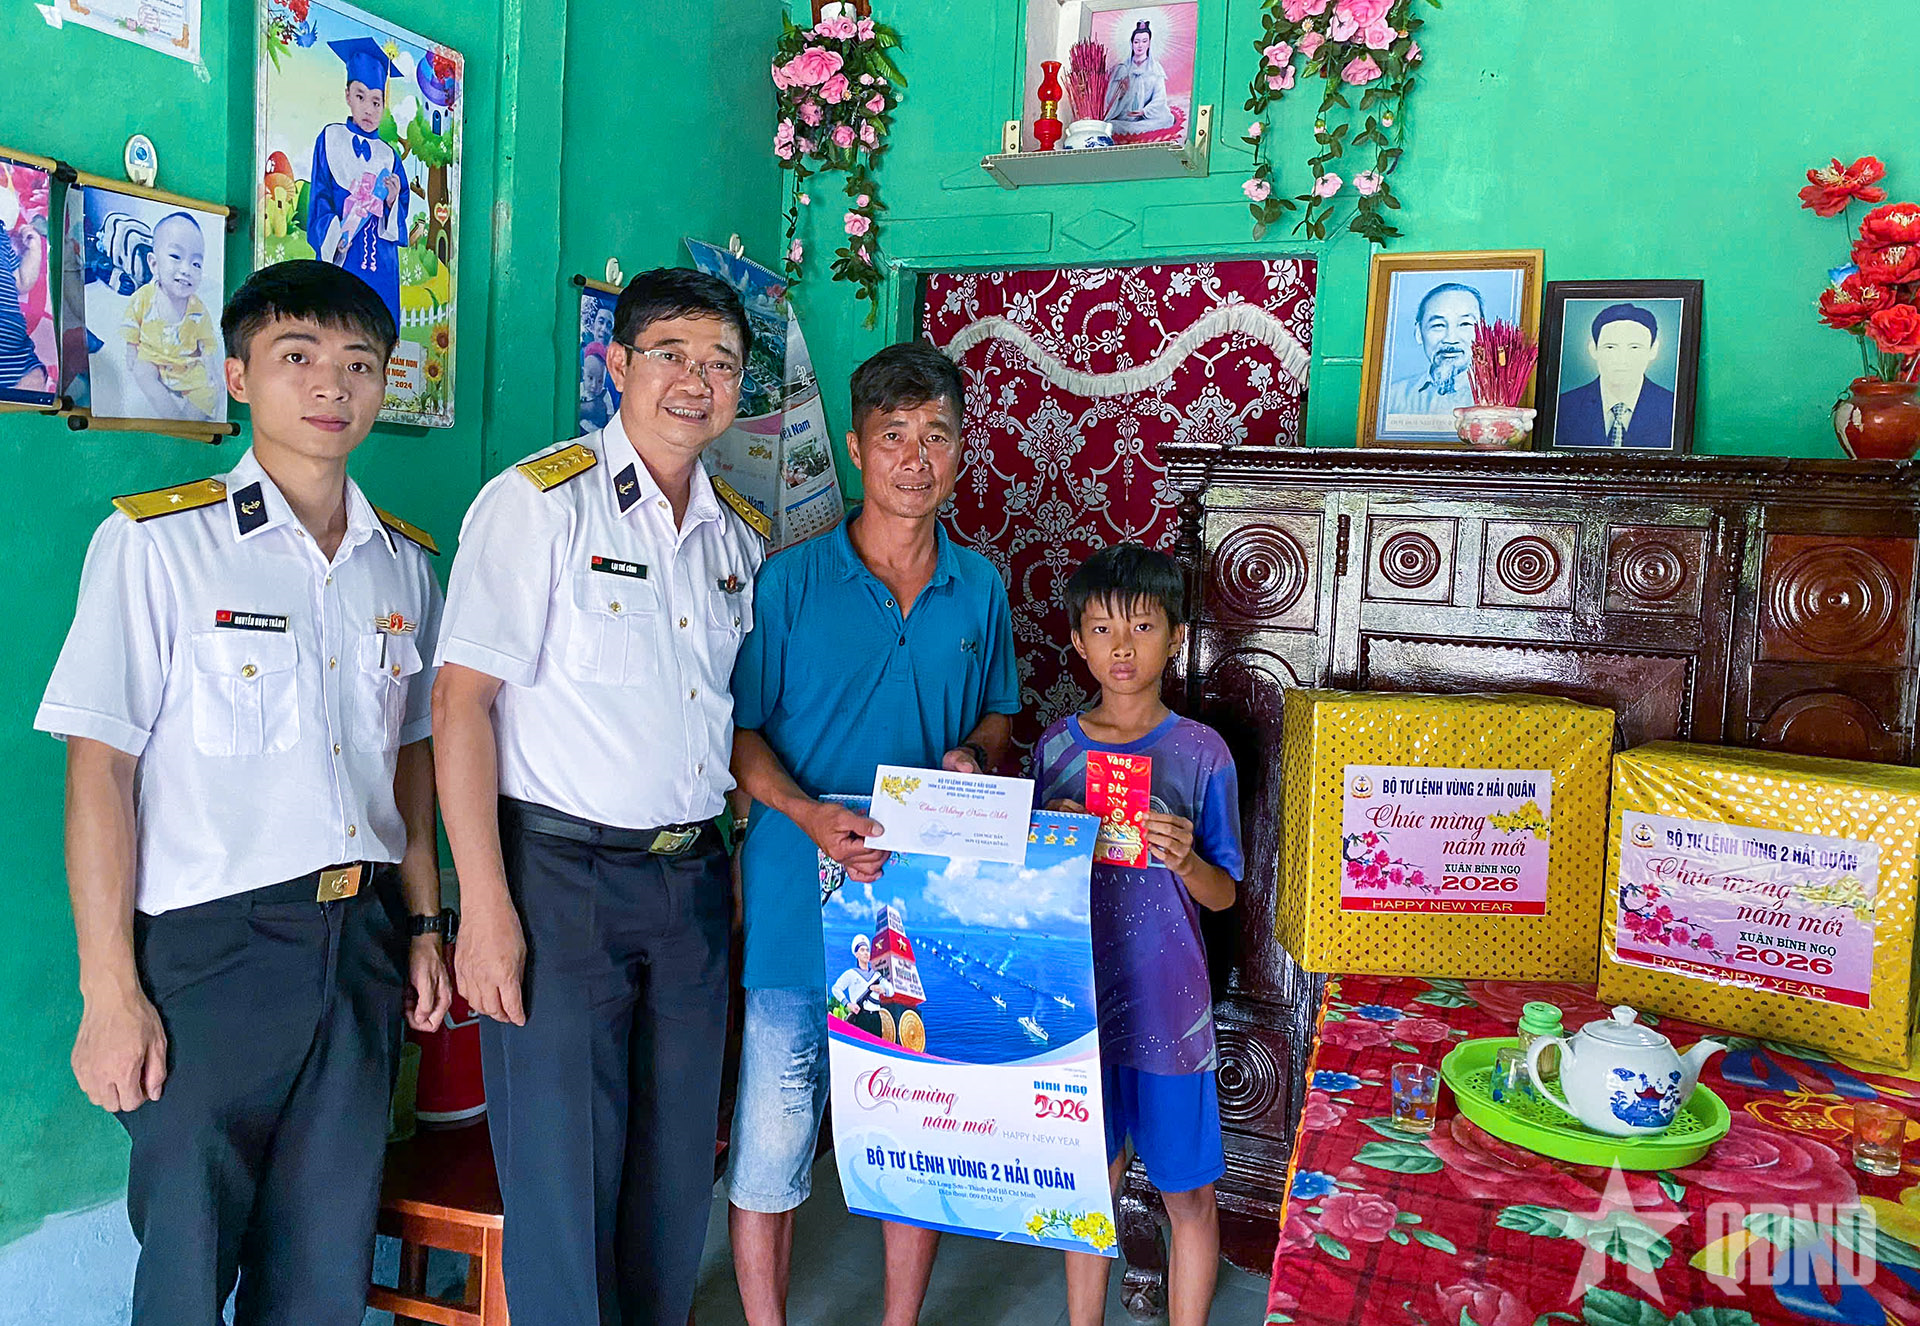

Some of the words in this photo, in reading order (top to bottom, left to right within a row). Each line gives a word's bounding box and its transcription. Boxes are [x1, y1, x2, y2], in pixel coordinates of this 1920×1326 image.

[395, 381, 413, 389] 2024
[791, 419, 811, 436] Nam
[1383, 777, 1396, 797] BỘ
[1400, 779, 1414, 795] TƯ
[1416, 778, 1443, 798] LỆNH
[1446, 778, 1474, 797] VÙNG
[1477, 783, 1484, 797] 2
[1486, 777, 1504, 797] HẢI
[1507, 780, 1536, 798] QUÂN
[1365, 804, 1425, 828] Chúc
[1430, 811, 1486, 840] mừng
[1442, 838, 1486, 856] năm
[1491, 836, 1527, 857] mới
[1666, 828, 1682, 851] BỘ
[1687, 833, 1703, 848] TƯ
[1705, 833, 1737, 855] LỆNH
[1742, 838, 1777, 860] VÙNG
[1780, 846, 1789, 862] 2
[1792, 843, 1816, 866] HẢI
[1819, 850, 1858, 872] QUÂN
[1445, 862, 1473, 873] XUÂN
[1500, 864, 1521, 876] NGỌ
[1441, 875, 1519, 892] 2026
[1372, 899, 1424, 910] HAPPY
[1430, 900, 1466, 911] NEW
[1471, 902, 1513, 912] YEAR
[1738, 905, 1791, 929] năm
[1798, 914, 1845, 937] mới
[1740, 931, 1774, 946] XUÂN
[1810, 943, 1837, 959] NGỌ
[1735, 944, 1834, 975] 2026
[1653, 956, 1716, 976] HAPPY
[1719, 969, 1766, 986] NEW
[1771, 978, 1826, 998] YEAR
[854, 1066, 911, 1113] Chúc
[1065, 1084, 1088, 1096] NGỌ
[1034, 1094, 1089, 1122] 2026
[1003, 1130, 1030, 1142] HAPPY
[1032, 1134, 1056, 1145] NEW
[1056, 1137, 1080, 1147] YEAR
[866, 1145, 885, 1170] BỘ
[888, 1150, 906, 1169] TƯ
[909, 1150, 945, 1176] LỆNH
[947, 1155, 988, 1181] VÙNG
[991, 1163, 1001, 1181] 2
[1004, 1158, 1030, 1185] HẢI
[1033, 1167, 1076, 1191] QUÂN
